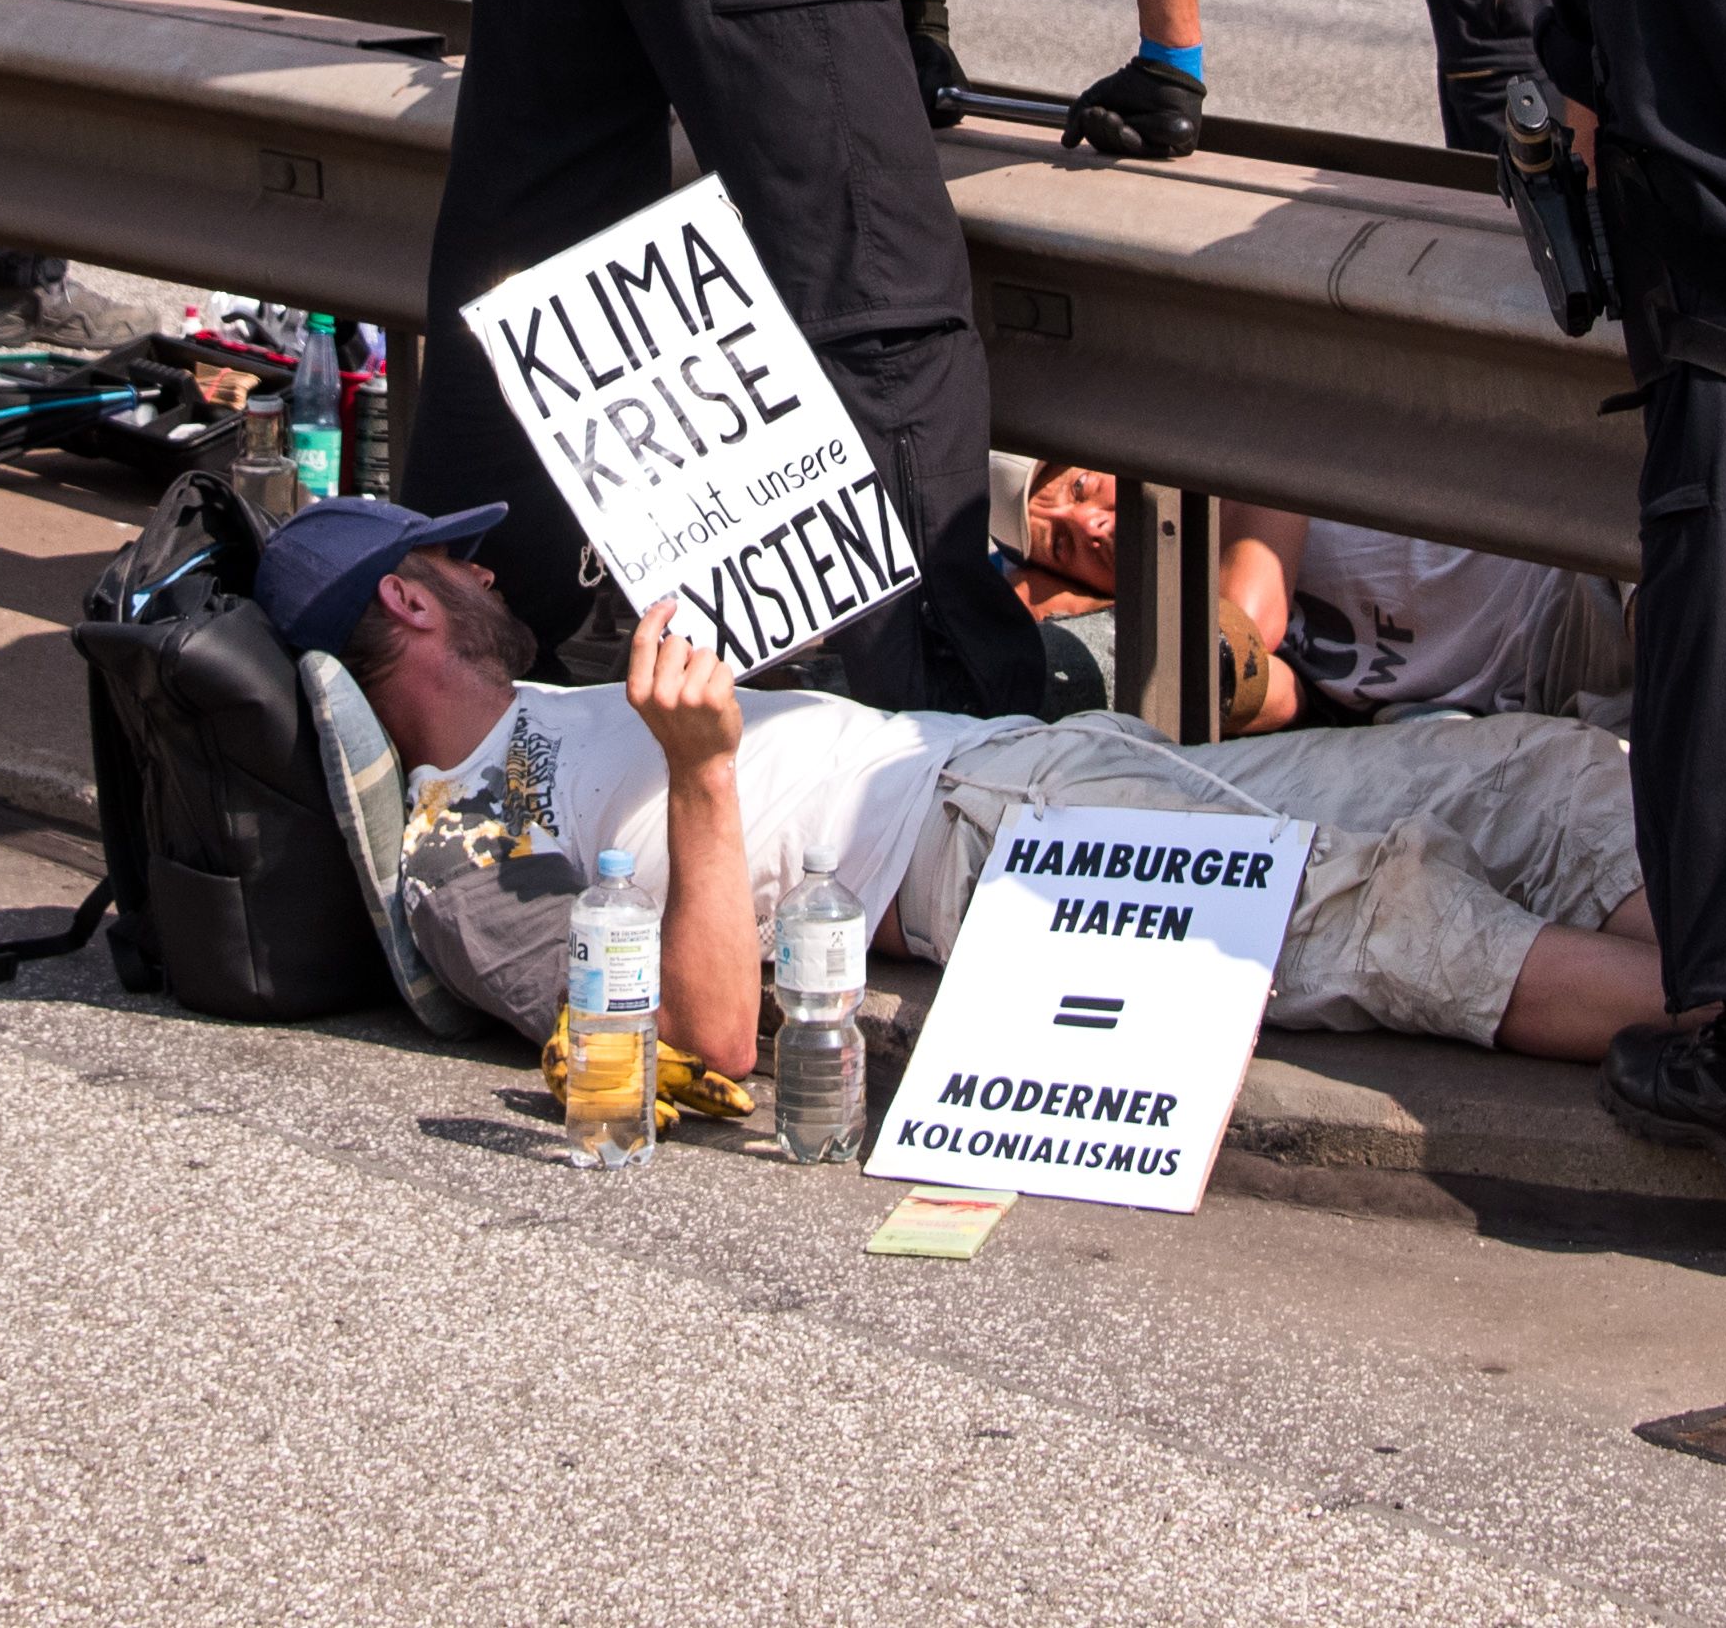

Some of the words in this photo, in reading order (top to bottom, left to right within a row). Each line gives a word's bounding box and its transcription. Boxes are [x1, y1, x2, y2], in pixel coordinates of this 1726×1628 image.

[499, 222, 754, 420] KLIMA
[553, 322, 802, 514] KRISE
[747, 438, 848, 507] unsere
[643, 478, 916, 670] XISTENZ
[1353, 603, 1414, 700] WF
[1004, 838, 1274, 889] HAMBURGER
[1049, 898, 1194, 942] HAFEN
[937, 1072, 1178, 1127] MODERNER
[897, 1118, 1181, 1176] KOLONIALISMUS
